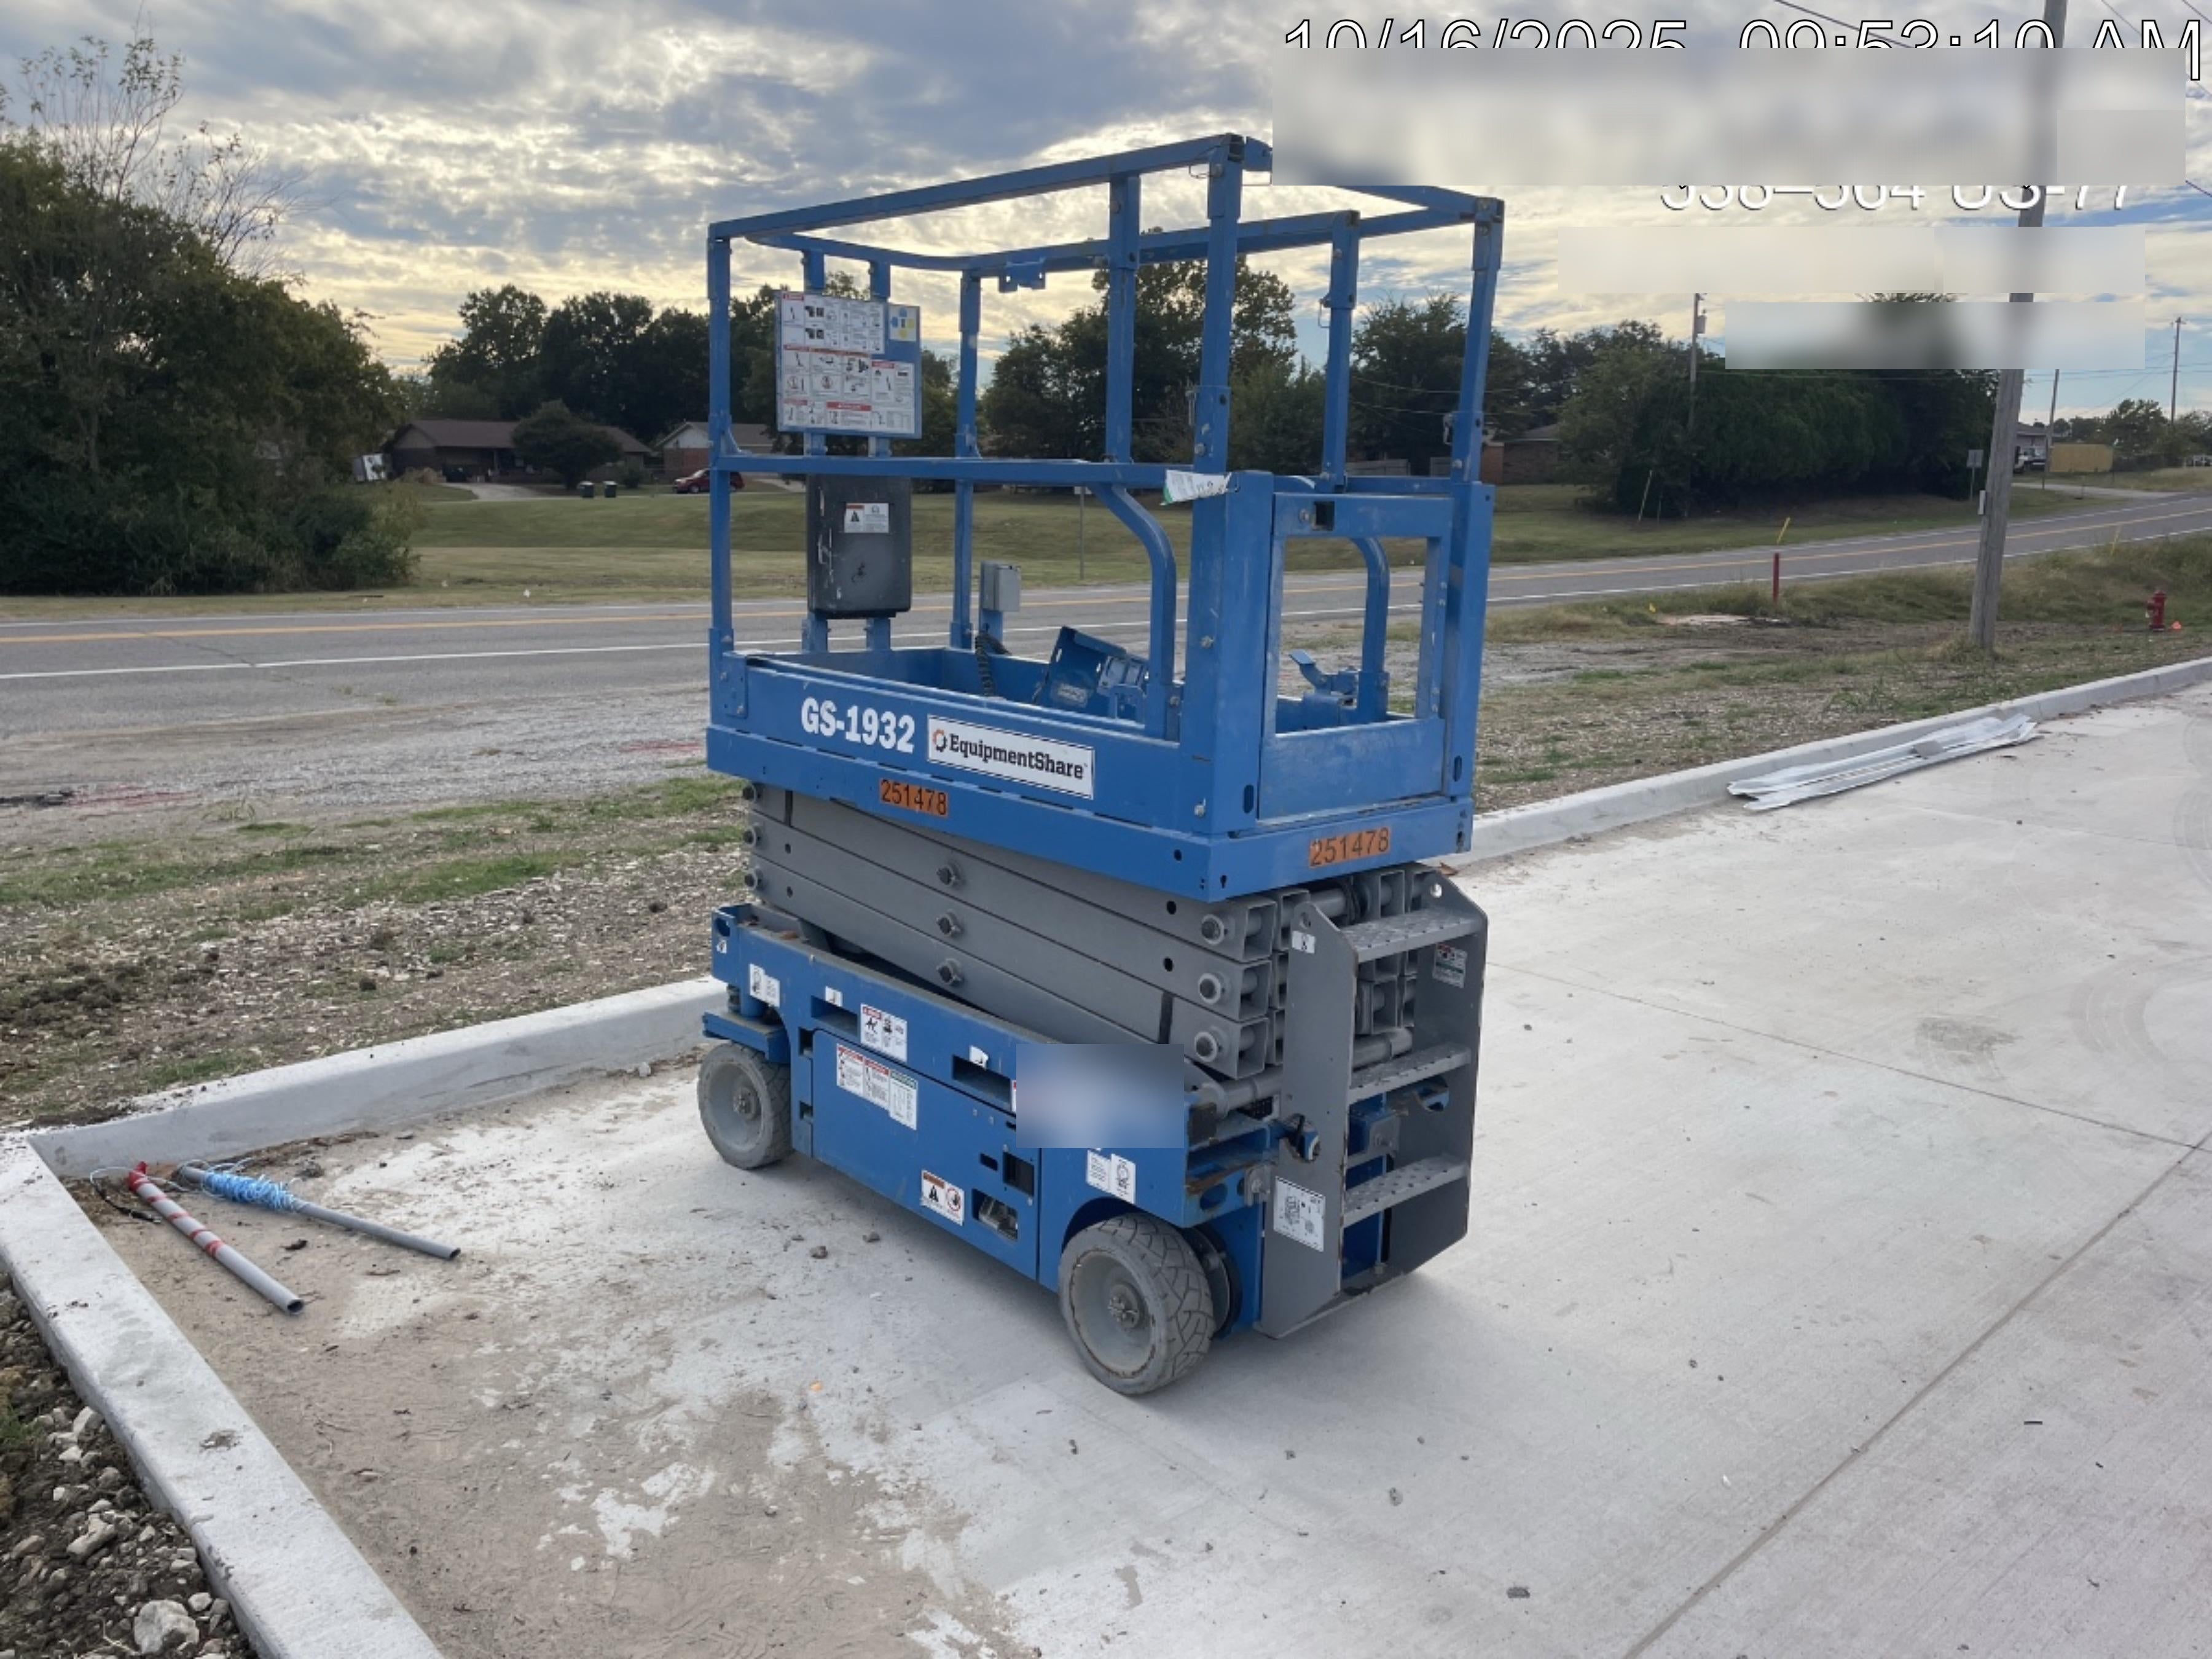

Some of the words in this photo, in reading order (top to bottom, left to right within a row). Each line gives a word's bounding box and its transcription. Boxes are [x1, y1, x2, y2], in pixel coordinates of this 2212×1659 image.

[801, 697, 916, 755] GS-1932
[949, 733, 1084, 780] EquipmentShare
[880, 779, 947, 816] 251478
[1309, 826, 1389, 867] 251478
